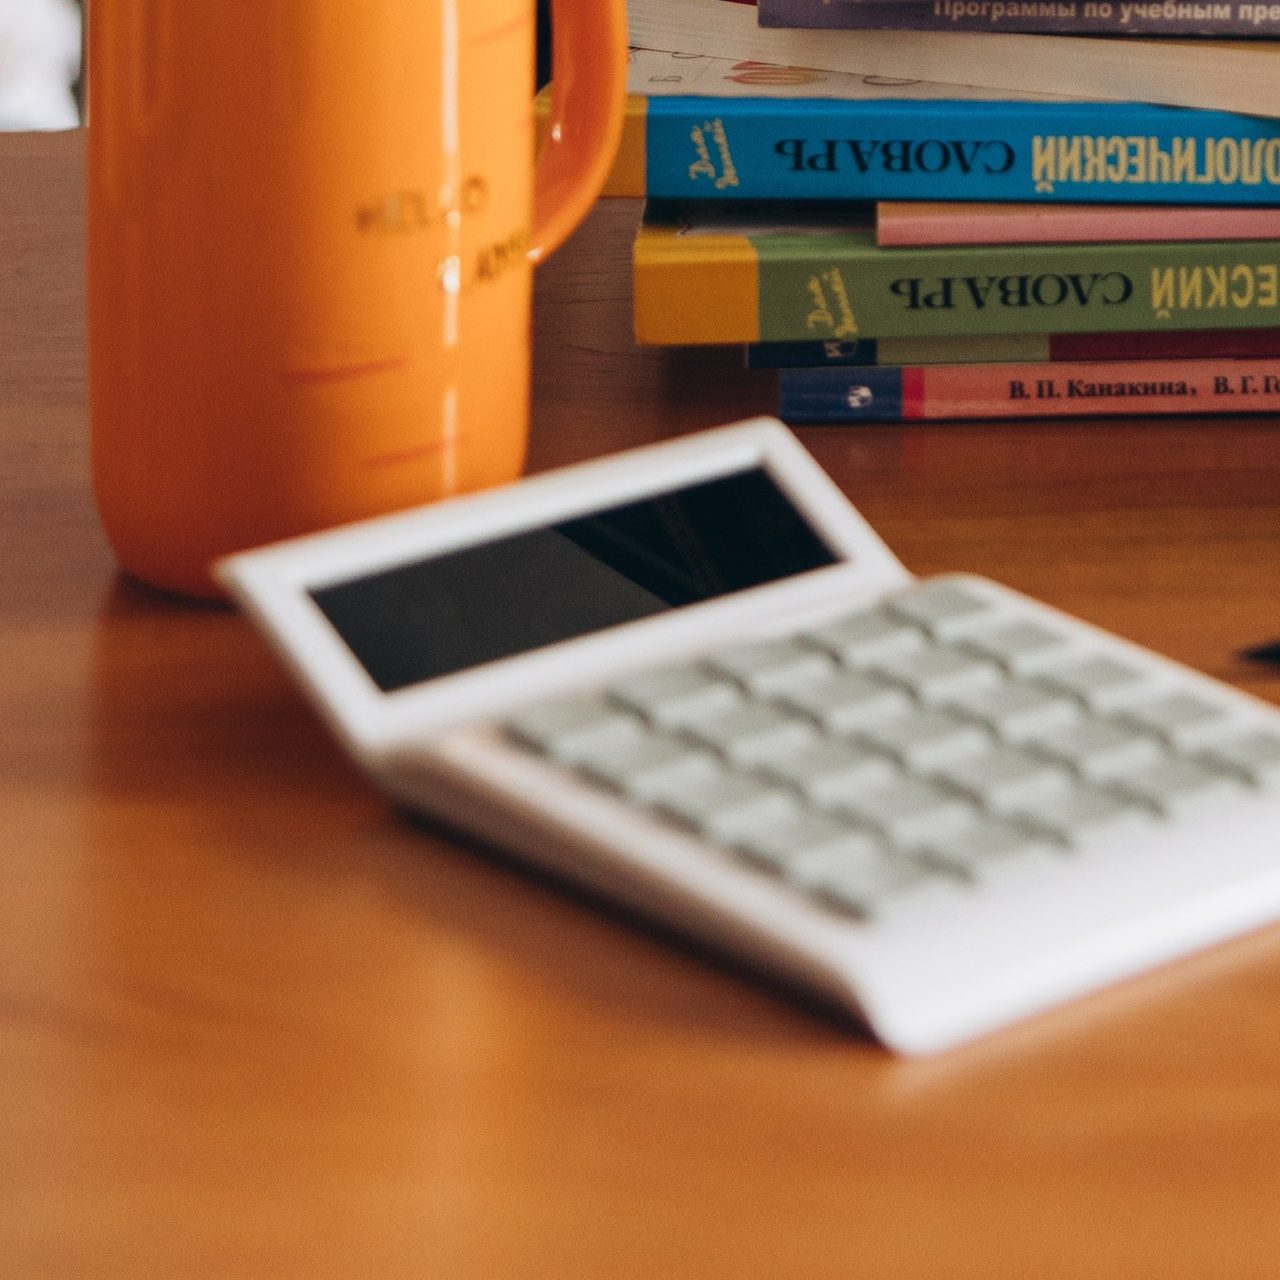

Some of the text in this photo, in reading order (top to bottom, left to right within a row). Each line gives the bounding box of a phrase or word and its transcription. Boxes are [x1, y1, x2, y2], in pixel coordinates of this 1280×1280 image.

[1084, 1, 1112, 19] по
[774, 139, 1016, 175] СЛОВАРЬ
[889, 271, 1134, 311] СЛОВАРЬ
[1008, 379, 1031, 401] В.
[1036, 378, 1061, 400] П.
[1066, 377, 1198, 400] Канакина,
[1212, 375, 1235, 396] В.
[1240, 374, 1258, 395] Г.
